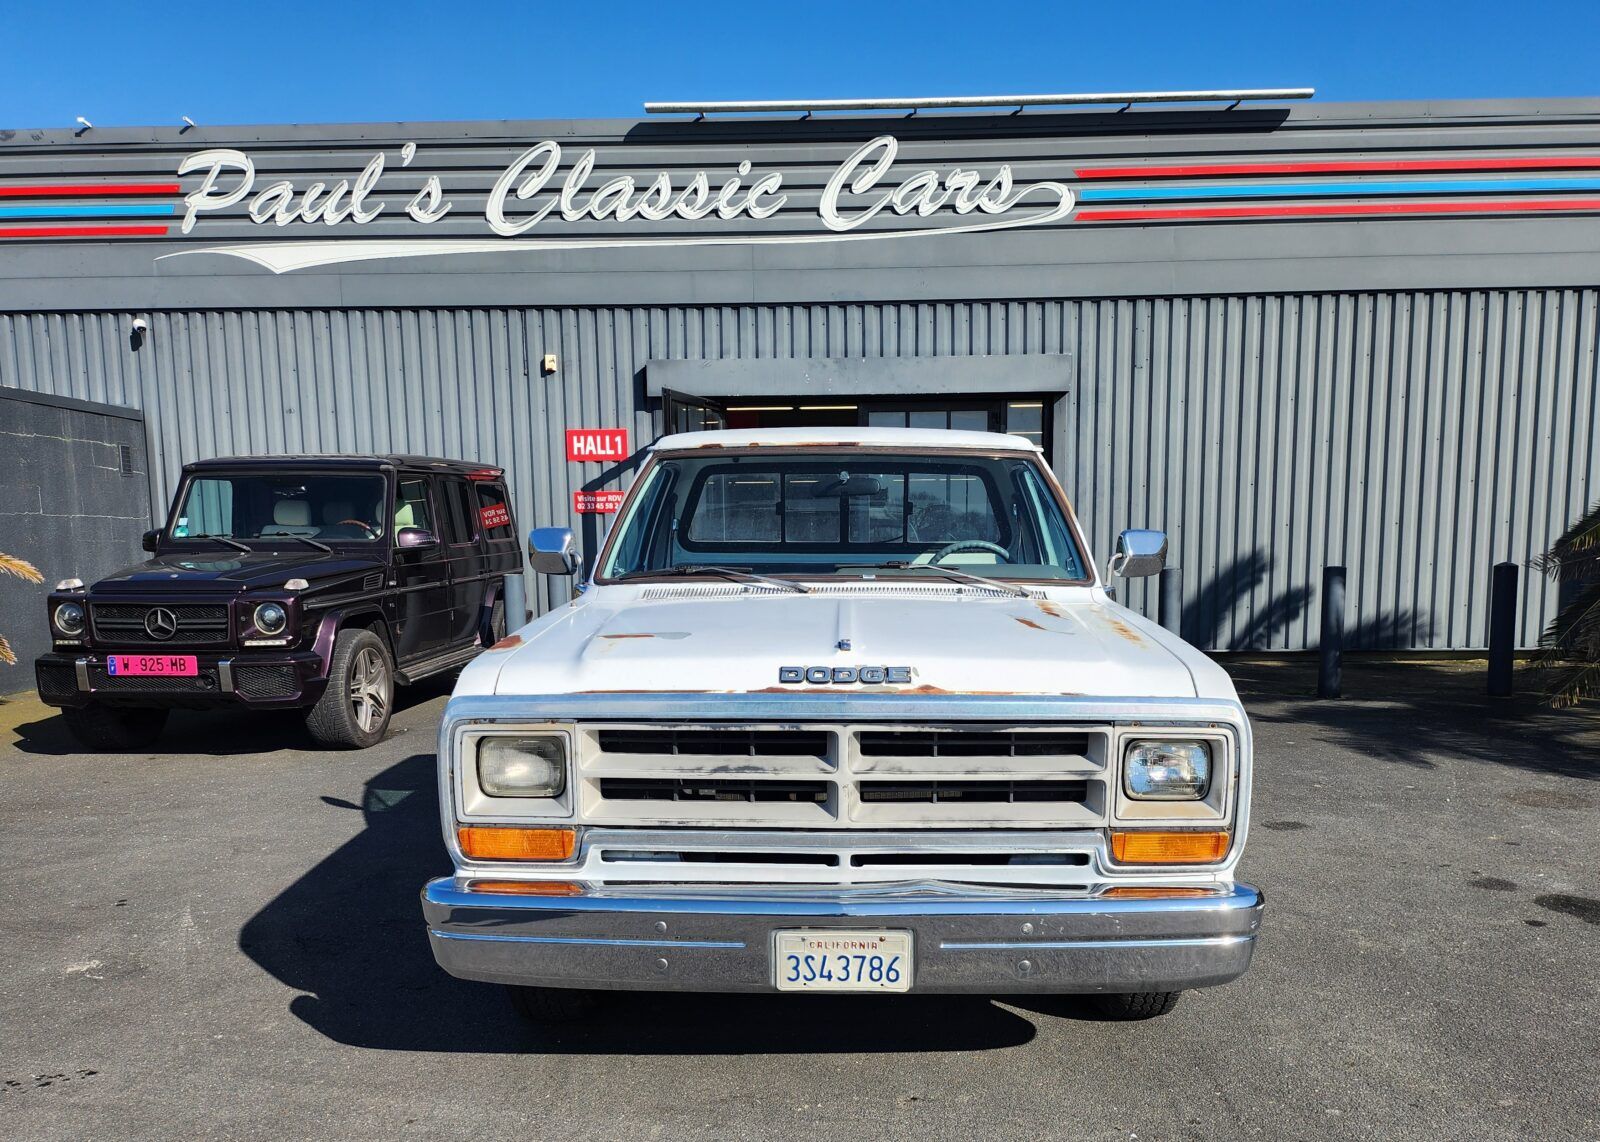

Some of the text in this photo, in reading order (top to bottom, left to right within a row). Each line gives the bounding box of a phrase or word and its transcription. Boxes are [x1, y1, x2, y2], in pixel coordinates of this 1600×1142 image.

[177, 134, 1075, 236] Paul's Classic Cars
[577, 494, 596, 502] Visite
[608, 494, 622, 502] RDV
[577, 502, 586, 510] 02
[587, 502, 595, 510] 33
[596, 502, 604, 510] 45
[605, 502, 614, 510] 58
[779, 666, 912, 684] DODGE
[809, 941, 878, 950] CALIFORNIA
[786, 954, 900, 983] 3S43786
